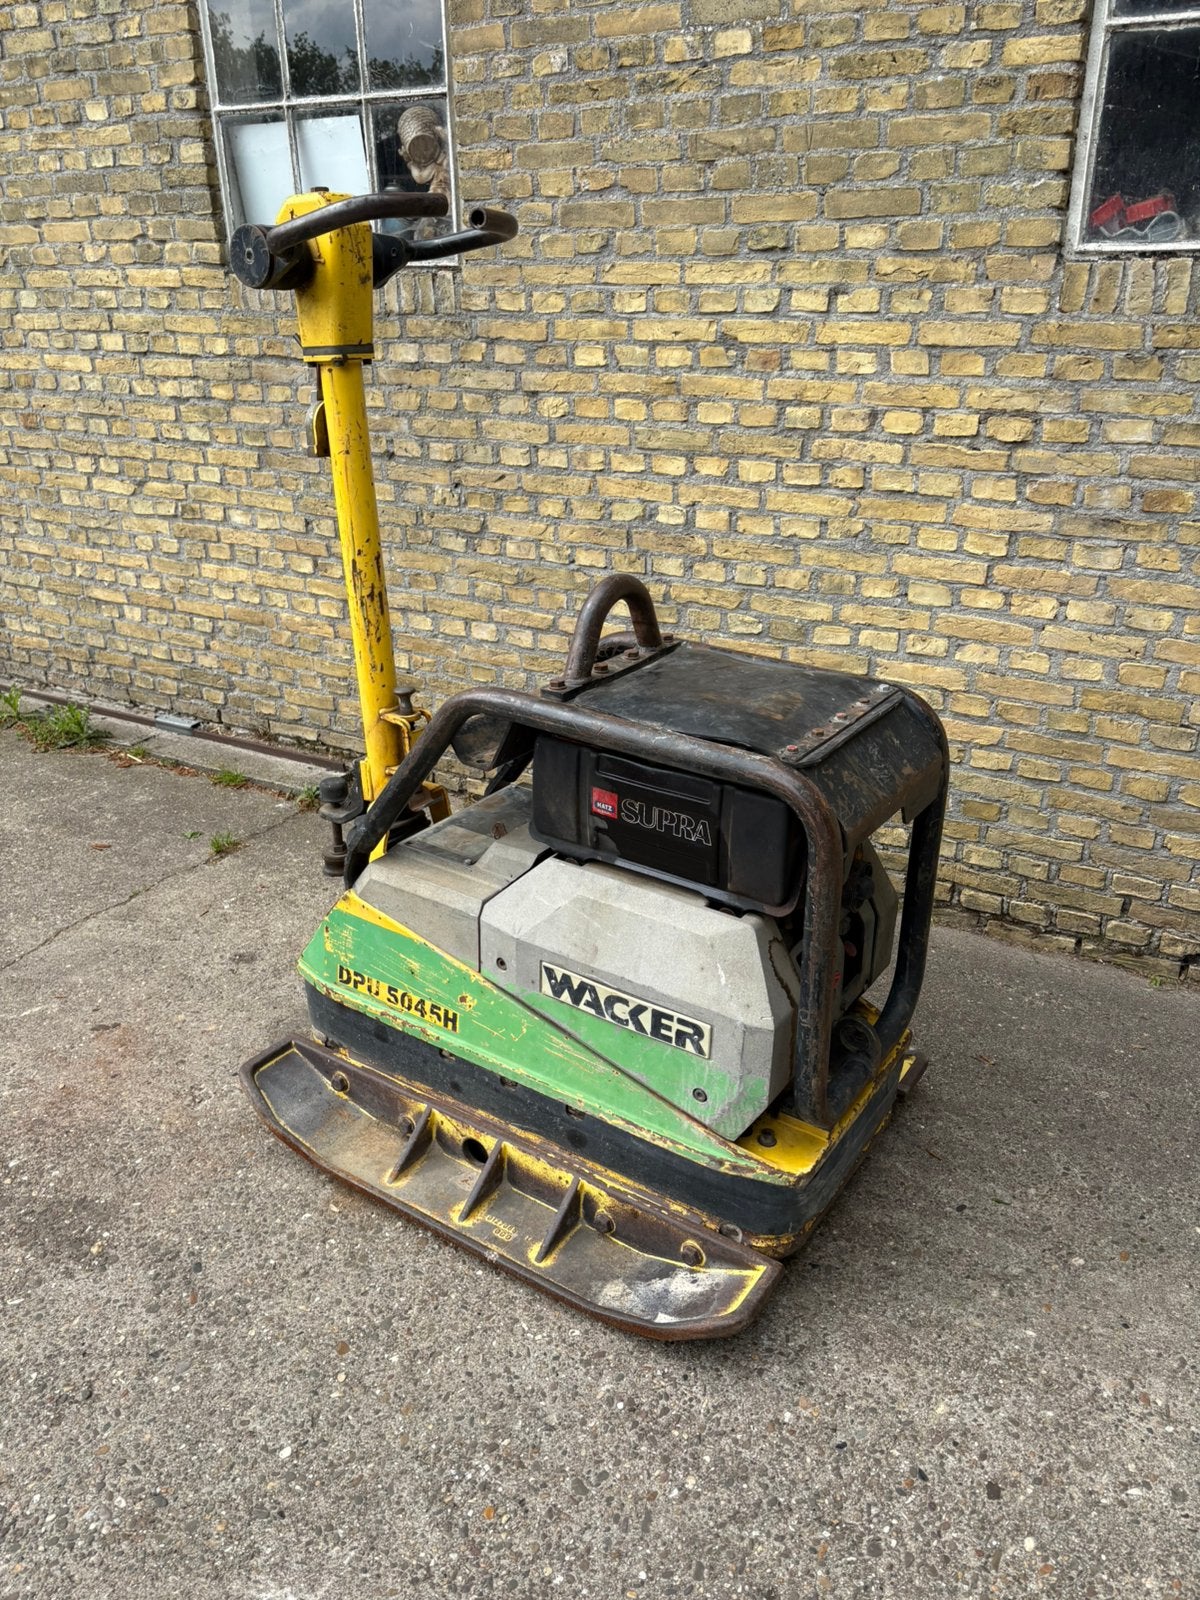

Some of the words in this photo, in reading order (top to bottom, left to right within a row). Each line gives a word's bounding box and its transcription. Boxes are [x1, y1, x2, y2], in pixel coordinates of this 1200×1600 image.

[596, 801, 613, 812] HATZ
[621, 799, 712, 846] SUPRA
[338, 965, 380, 996] DPU
[387, 986, 458, 1032] 5045H
[543, 965, 706, 1056] WACKER
